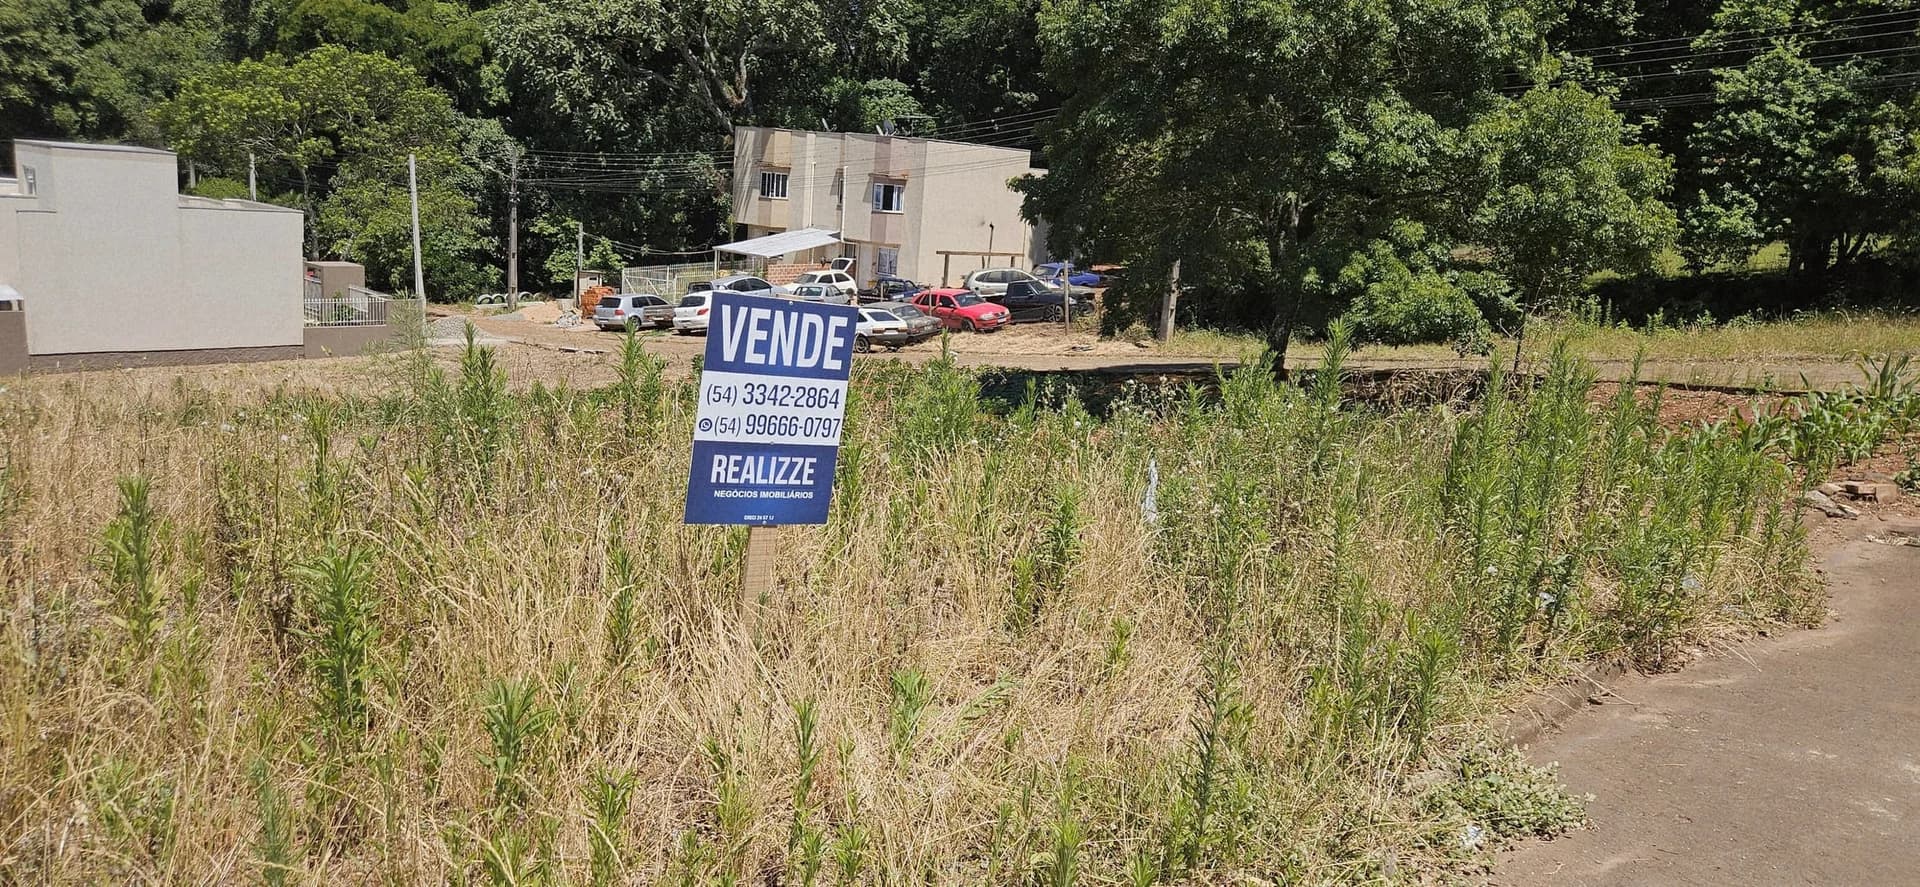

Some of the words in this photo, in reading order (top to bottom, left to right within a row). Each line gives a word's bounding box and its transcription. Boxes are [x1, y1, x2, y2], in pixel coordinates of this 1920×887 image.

[722, 305, 848, 370] VENDE
[706, 383, 738, 407] (54)
[742, 382, 840, 409] 3342-2864
[714, 416, 741, 437] (54)
[745, 414, 840, 438] 99666-0797
[711, 455, 817, 485] REALIZZE
[713, 489, 758, 498] NEGÓCIOS
[760, 490, 814, 499] IMOBILIÁRIOS
